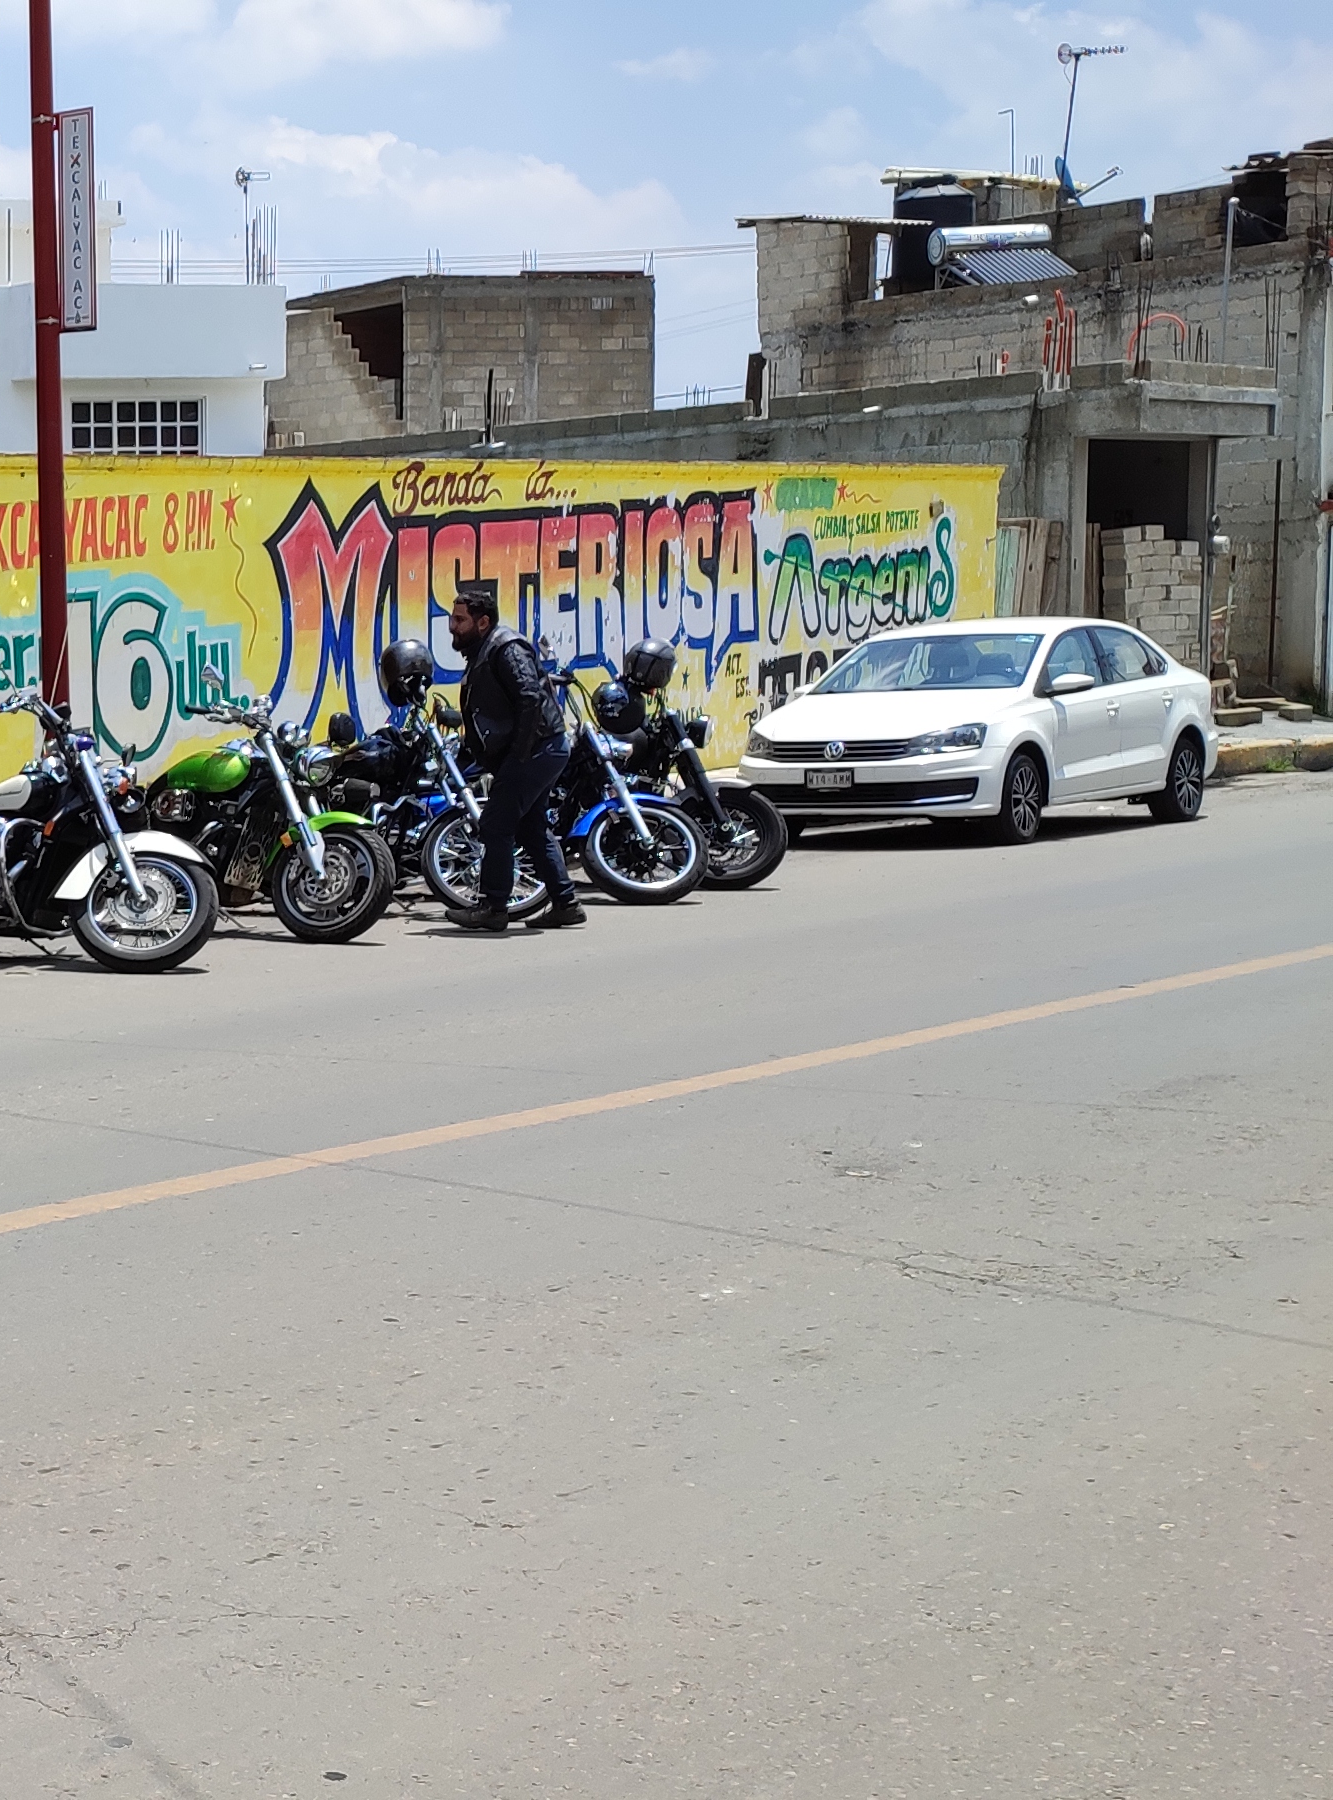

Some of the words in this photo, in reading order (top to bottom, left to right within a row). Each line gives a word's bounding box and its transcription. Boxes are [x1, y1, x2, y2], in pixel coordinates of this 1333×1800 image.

[392, 461, 502, 517] Banda
[162, 492, 179, 553] 8
[814, 514, 847, 540] CUMBIA
[856, 511, 881, 535] SALSA
[885, 508, 919, 533] POTENTE
[264, 476, 759, 738] MISTERIOSA
[66, 590, 174, 762] 16
